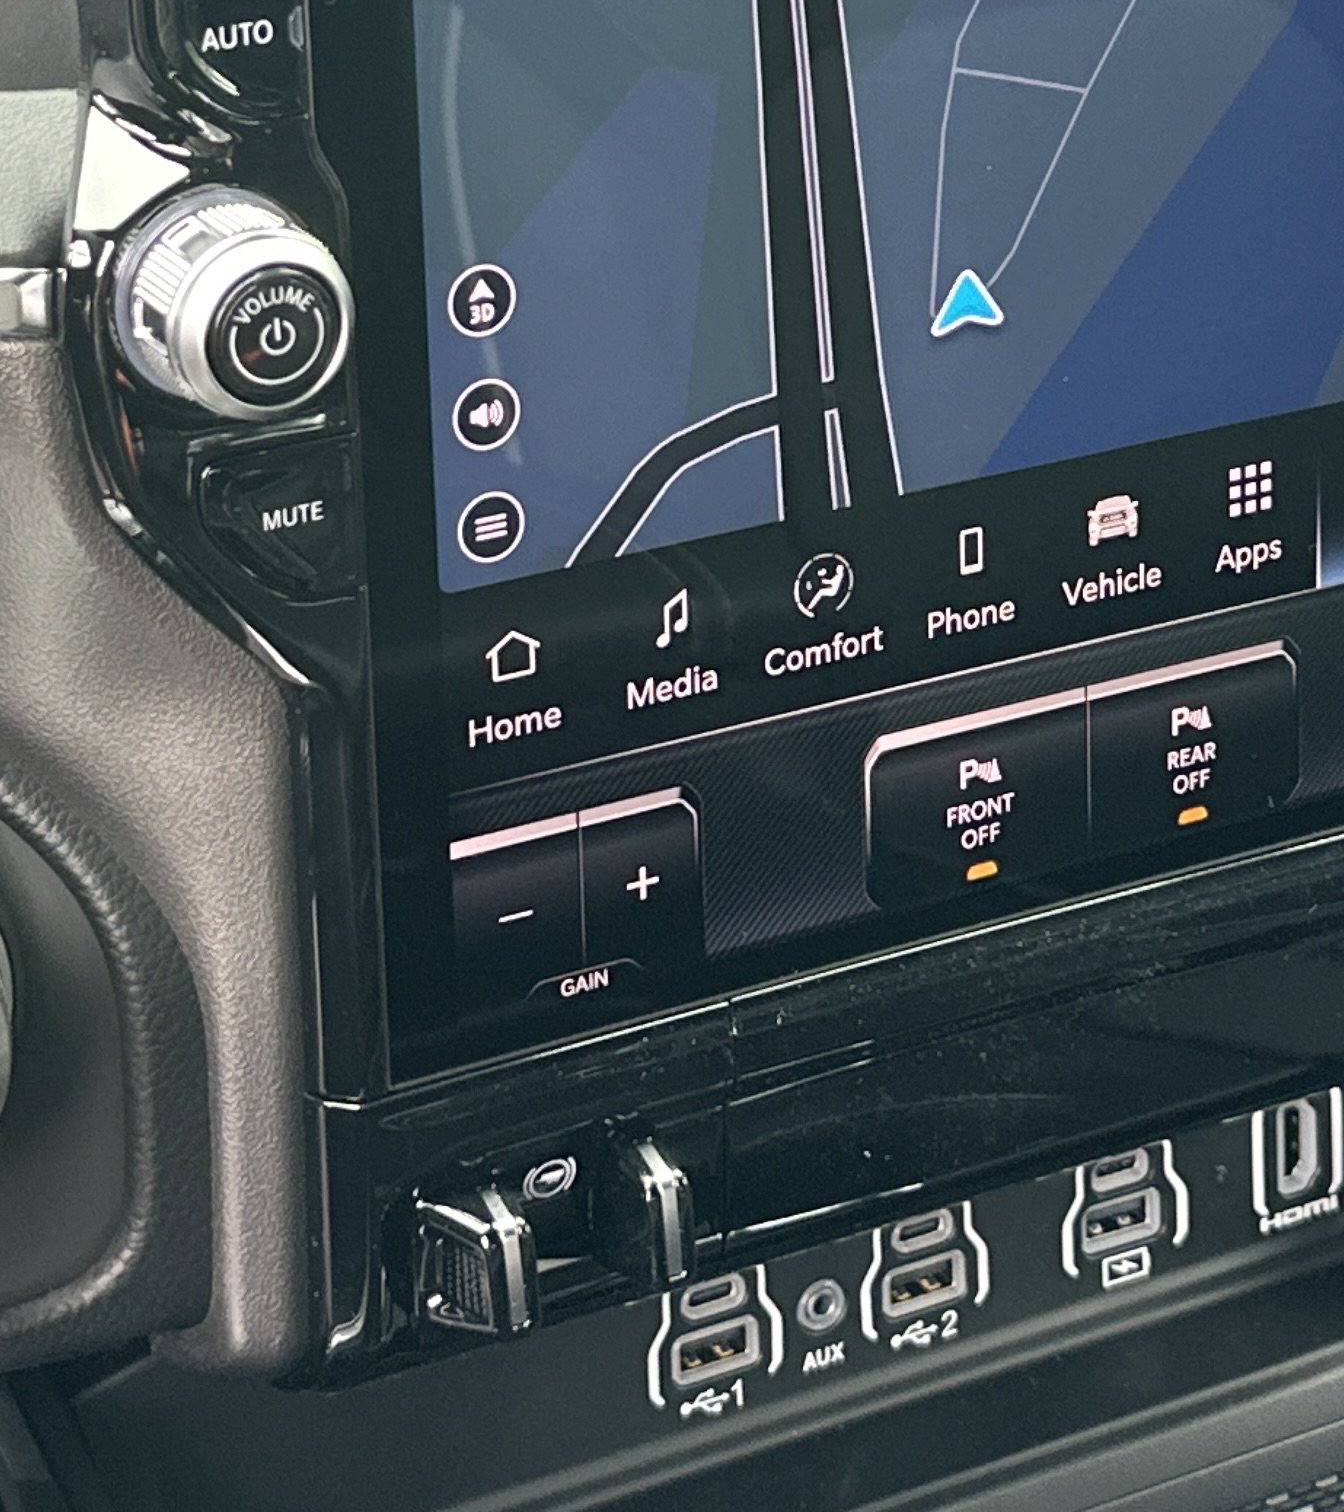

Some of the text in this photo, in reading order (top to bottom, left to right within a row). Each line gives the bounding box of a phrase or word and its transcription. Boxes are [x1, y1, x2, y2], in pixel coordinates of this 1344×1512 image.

[200, 19, 274, 53] AUTO
[232, 285, 315, 326] VOLUME
[469, 302, 496, 325] 3D
[261, 500, 325, 532] MUTE
[1214, 537, 1283, 575] Apps
[1062, 564, 1163, 606] Vehicle
[927, 599, 1016, 639] Phone
[764, 625, 885, 677] Comfort
[626, 665, 718, 710] Media
[468, 705, 563, 748] Home
[1167, 741, 1217, 771] REAR
[1172, 768, 1212, 795] OFF
[946, 792, 1015, 828] FRONT
[960, 822, 1001, 851] OFF
[559, 968, 609, 998] GAIN
[940, 1310, 959, 1339] 2
[802, 1340, 846, 1373] AUX
[732, 1378, 744, 1407] 1
